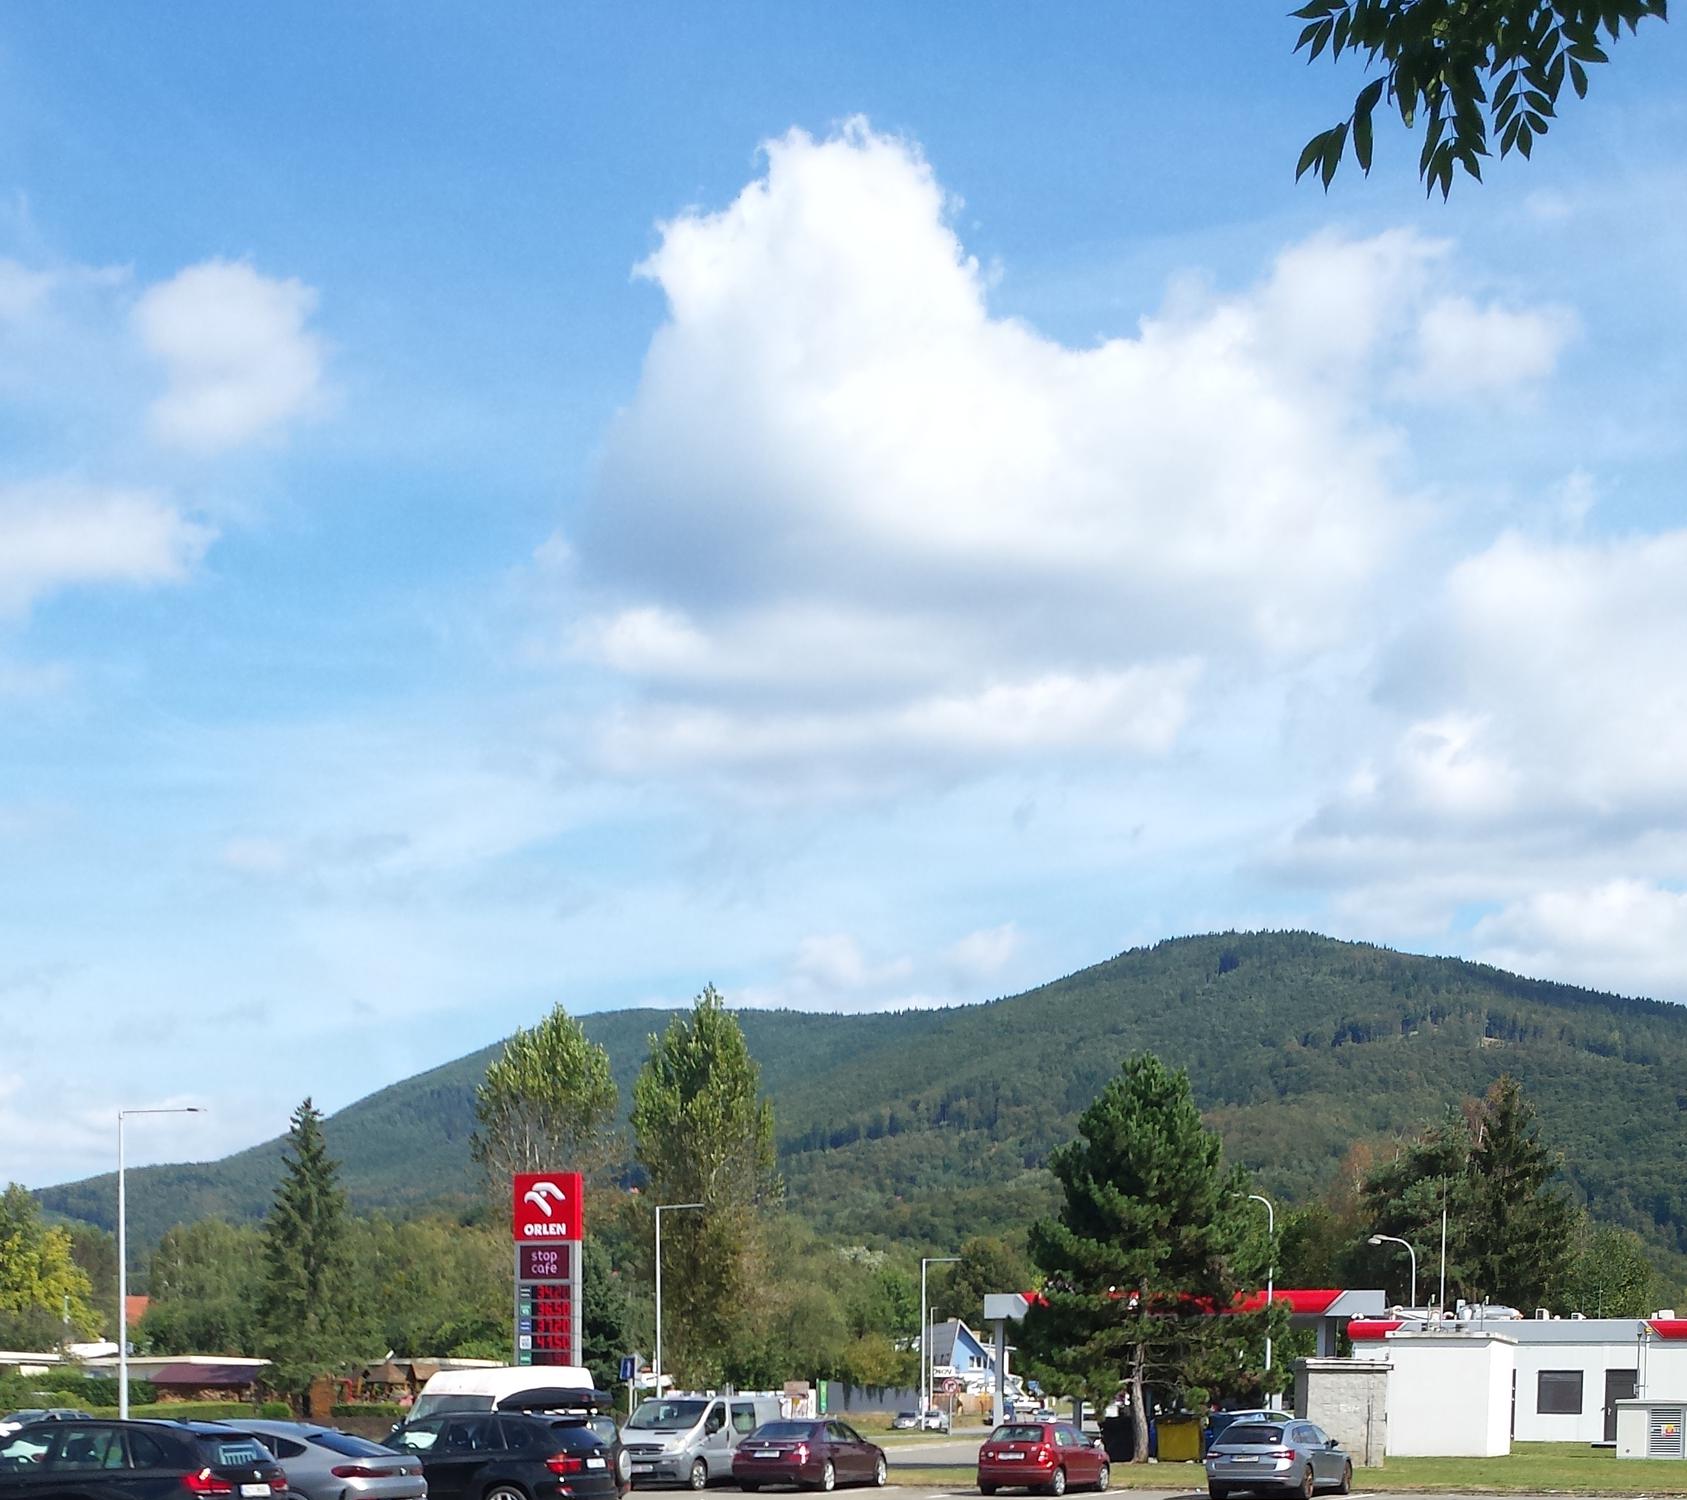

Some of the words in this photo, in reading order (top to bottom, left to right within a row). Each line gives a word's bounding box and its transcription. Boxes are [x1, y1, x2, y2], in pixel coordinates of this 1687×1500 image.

[523, 1222, 567, 1236] ORLEN
[531, 1250, 558, 1263] stop
[531, 1262, 558, 1275] cafe
